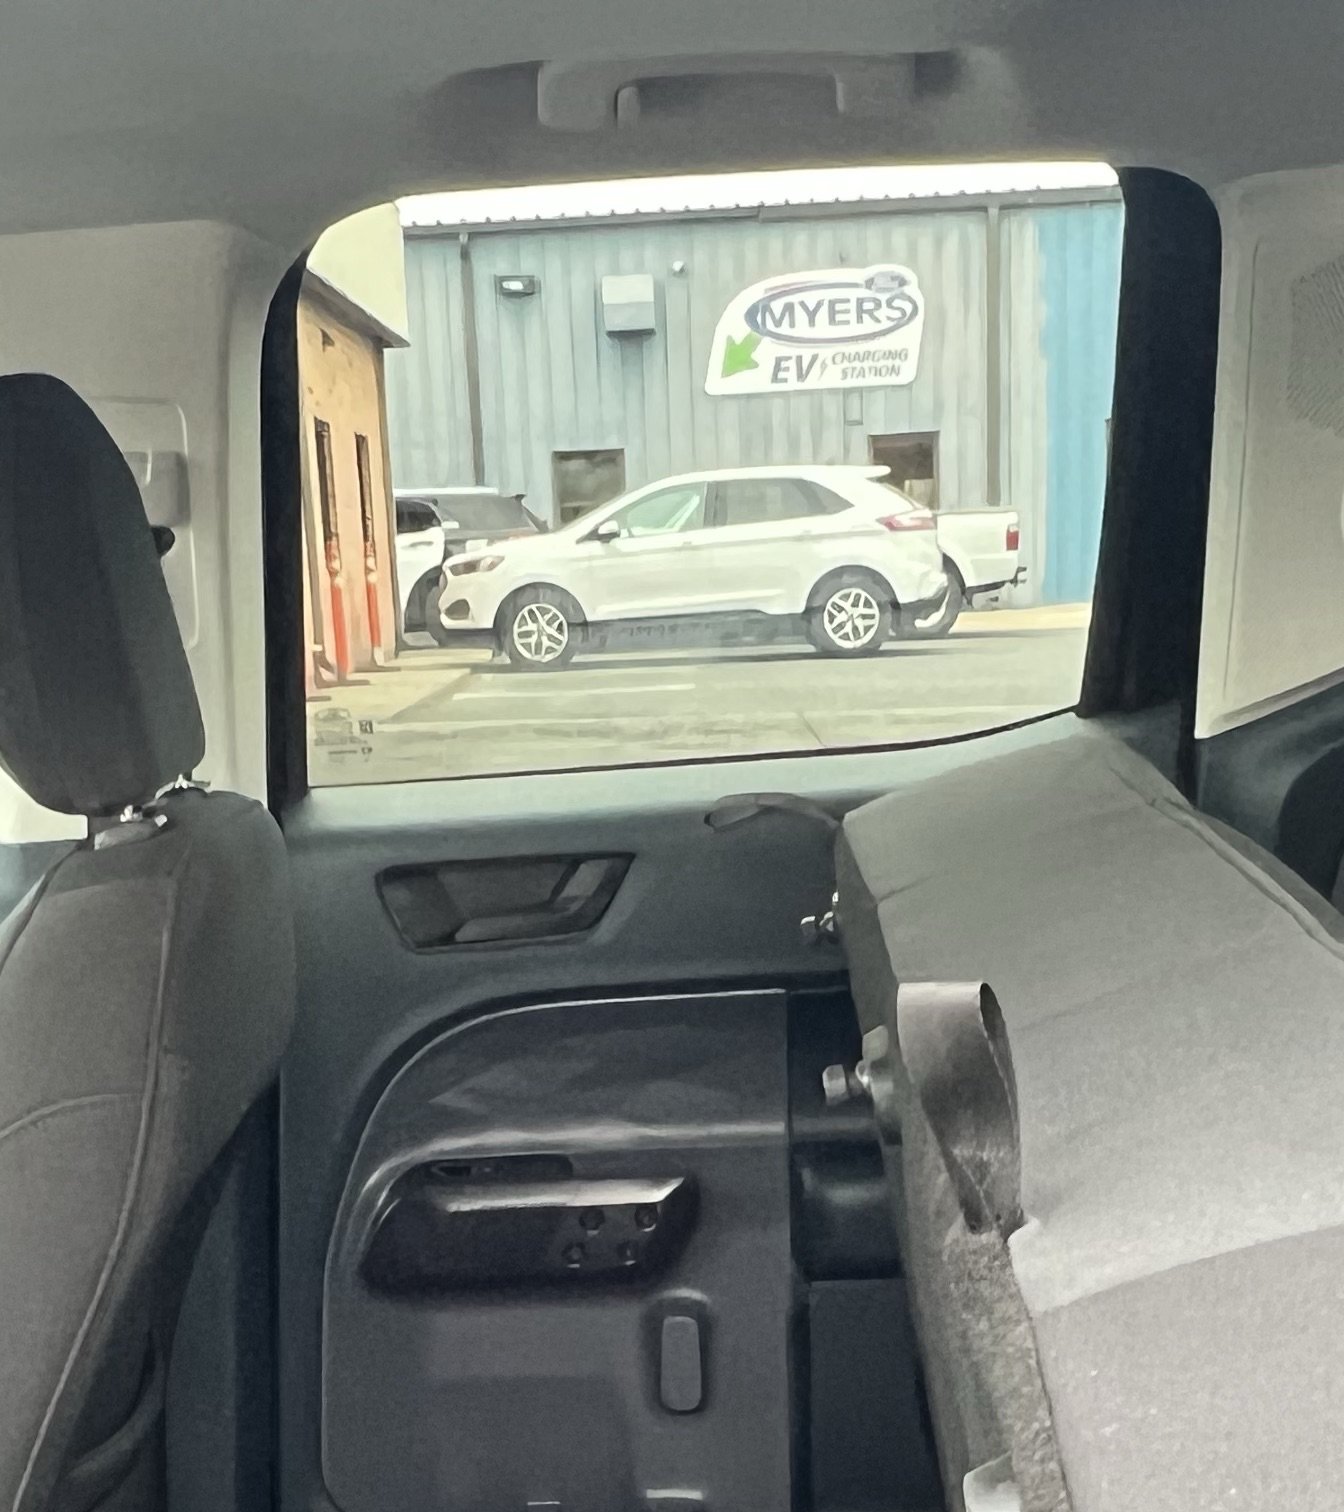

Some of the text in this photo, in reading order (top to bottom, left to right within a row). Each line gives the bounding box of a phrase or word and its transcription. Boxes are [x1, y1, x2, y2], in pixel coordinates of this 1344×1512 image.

[760, 294, 908, 329] MYERS
[831, 348, 909, 365] CHARGING
[771, 354, 819, 384] EV
[840, 364, 901, 380] STATION
